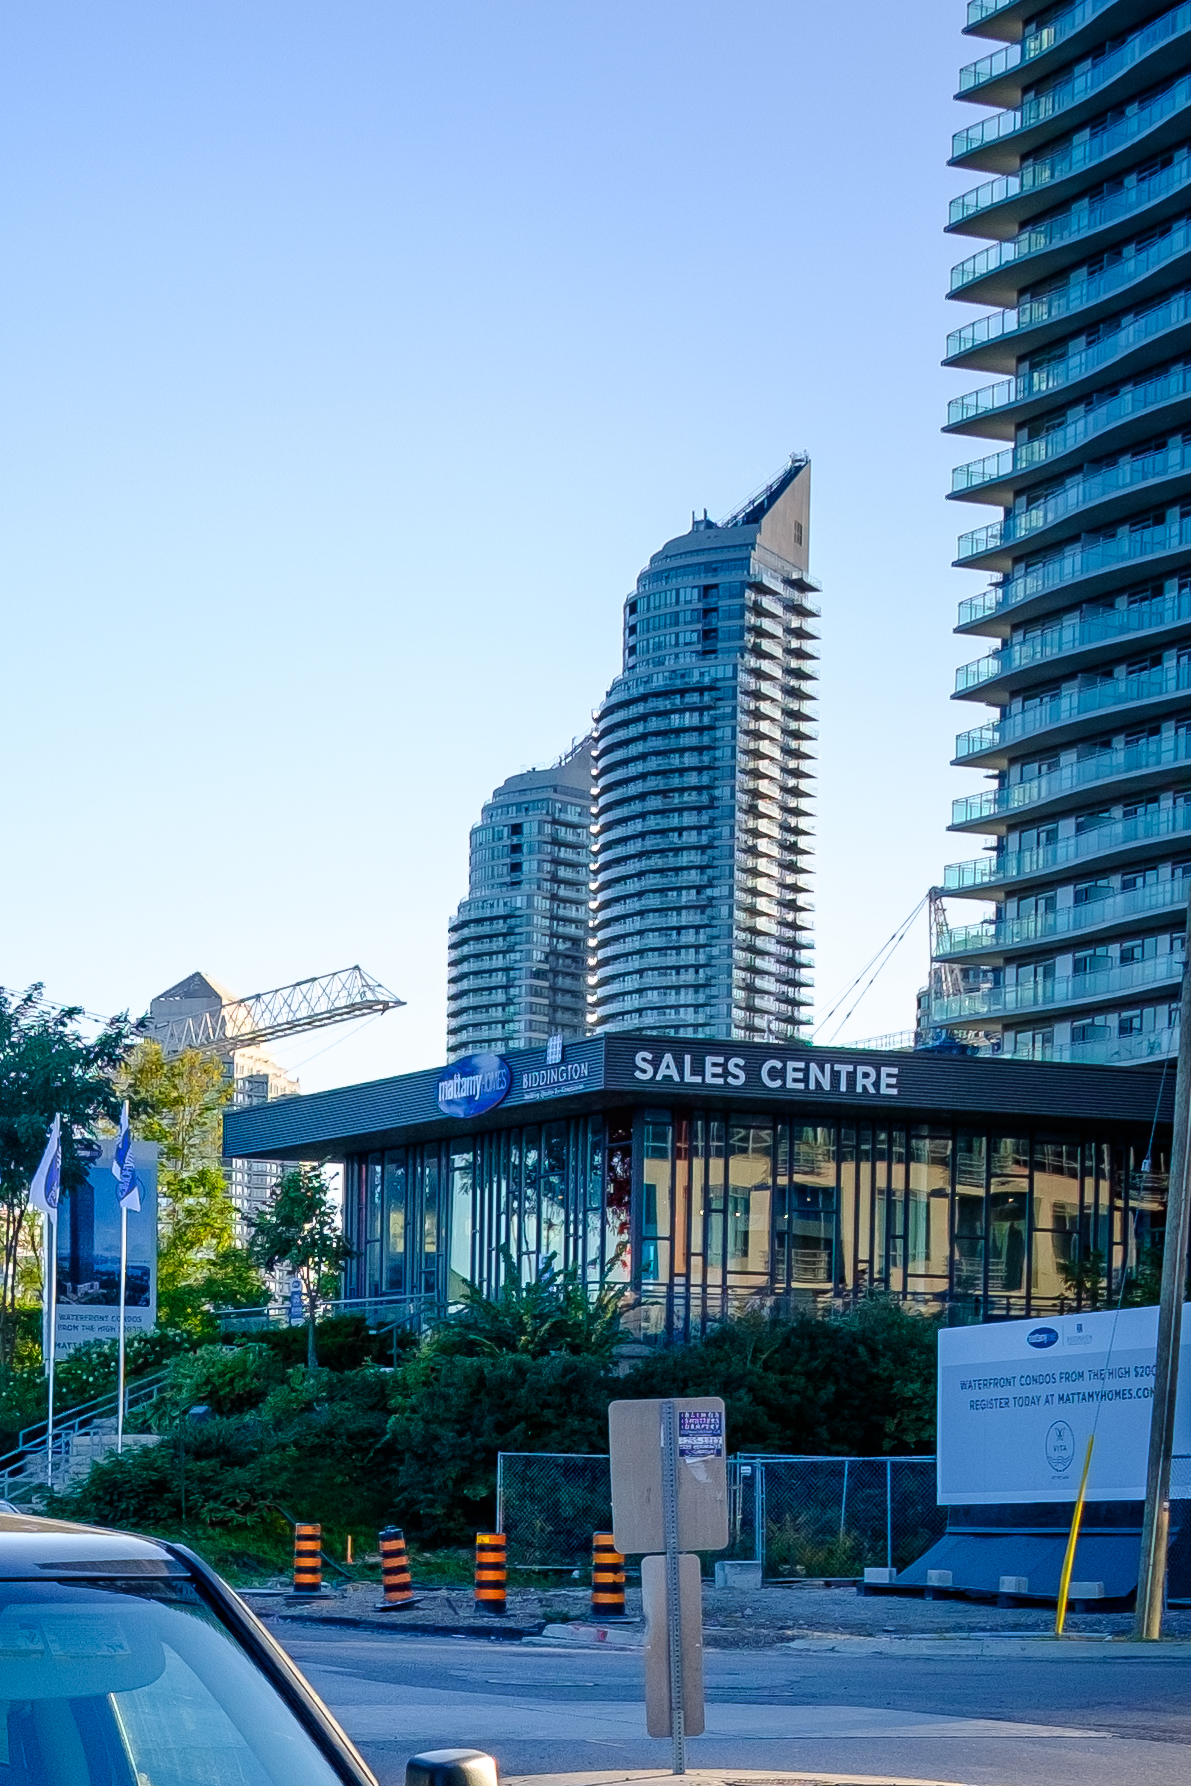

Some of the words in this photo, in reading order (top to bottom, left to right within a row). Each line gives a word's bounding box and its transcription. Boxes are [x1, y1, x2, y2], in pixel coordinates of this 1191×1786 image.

[522, 1061, 589, 1089] BIDDINGTON
[634, 1051, 746, 1086] SALES
[761, 1059, 899, 1095] CENTRE
[959, 1376, 1017, 1391] WATERFRONT
[1019, 1372, 1057, 1387] CONDOS
[1059, 1370, 1085, 1383] FROM
[1088, 1368, 1105, 1381] THE
[1107, 1366, 1130, 1380] HIGH
[969, 1397, 1010, 1411] REGISTER
[1012, 1394, 1042, 1408] TODAY
[1043, 1393, 1055, 1406] AT
